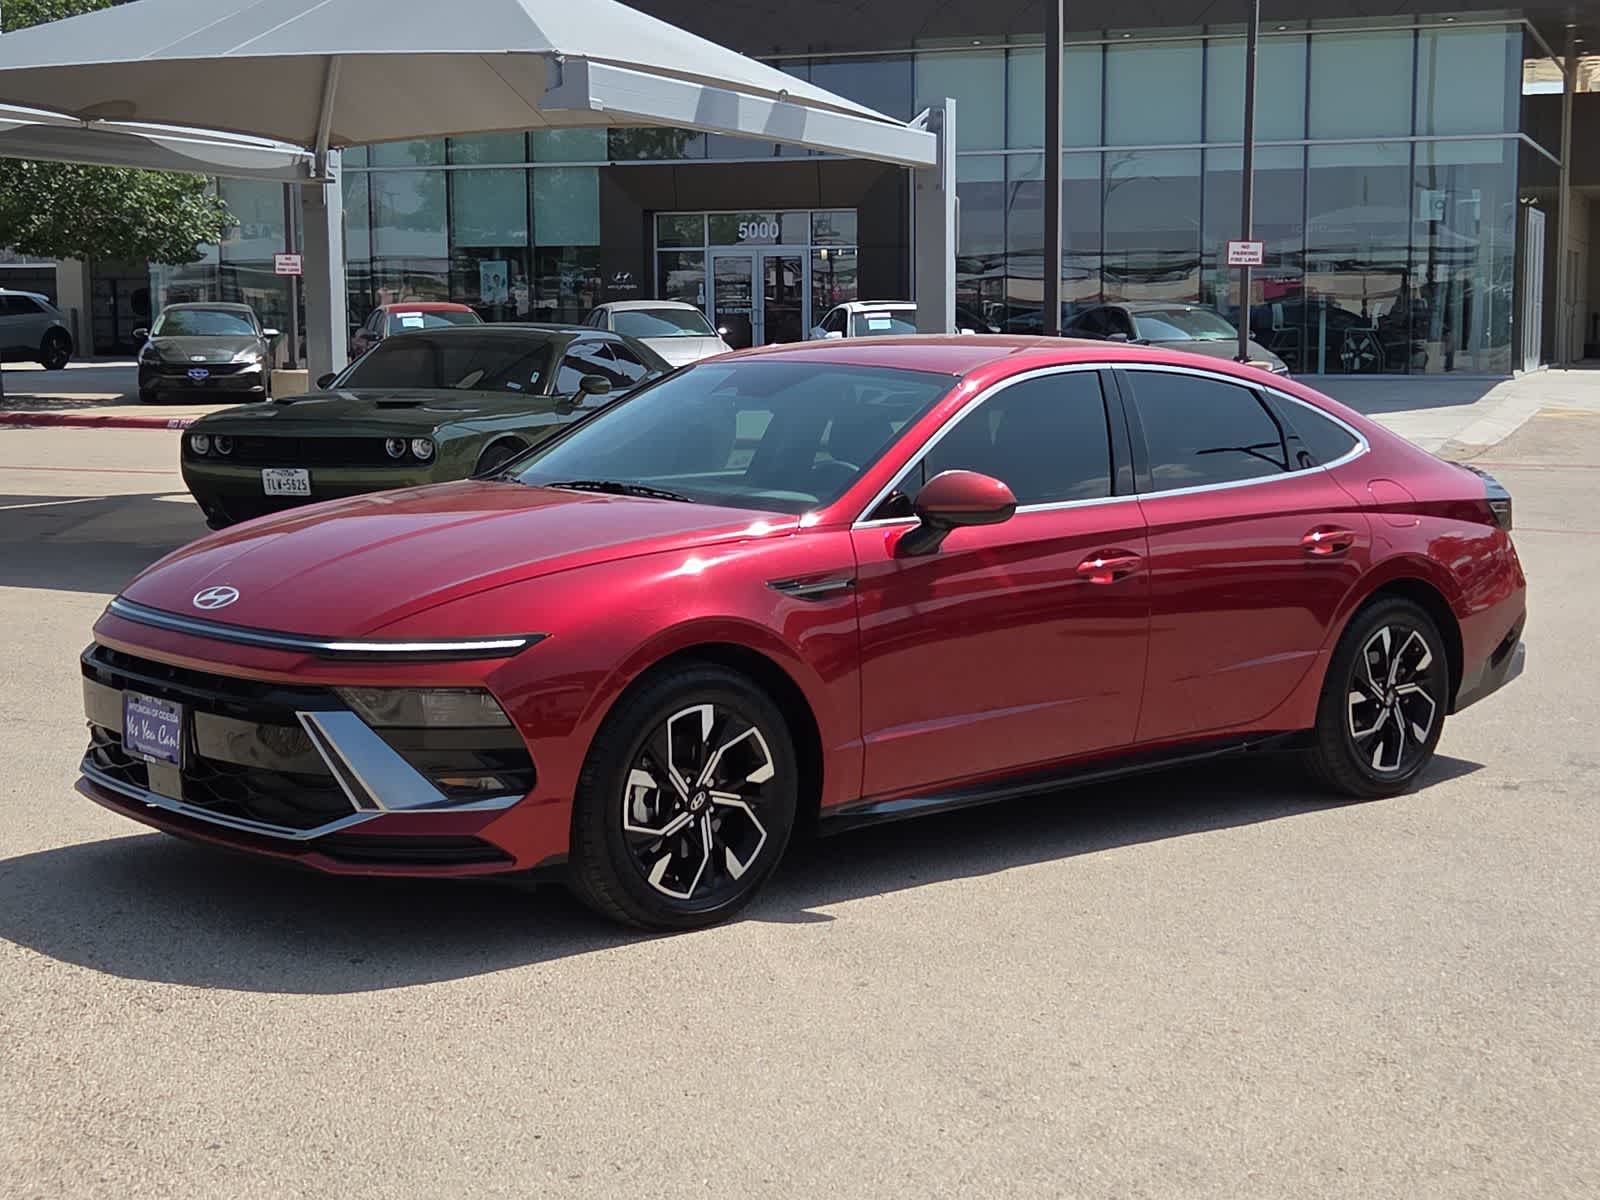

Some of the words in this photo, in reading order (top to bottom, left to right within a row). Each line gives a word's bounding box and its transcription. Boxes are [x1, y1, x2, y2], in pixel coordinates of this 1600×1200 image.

[738, 222, 779, 239] 5000
[126, 714, 139, 737] Yes
[141, 719, 156, 740] You
[158, 724, 181, 750] Can!
